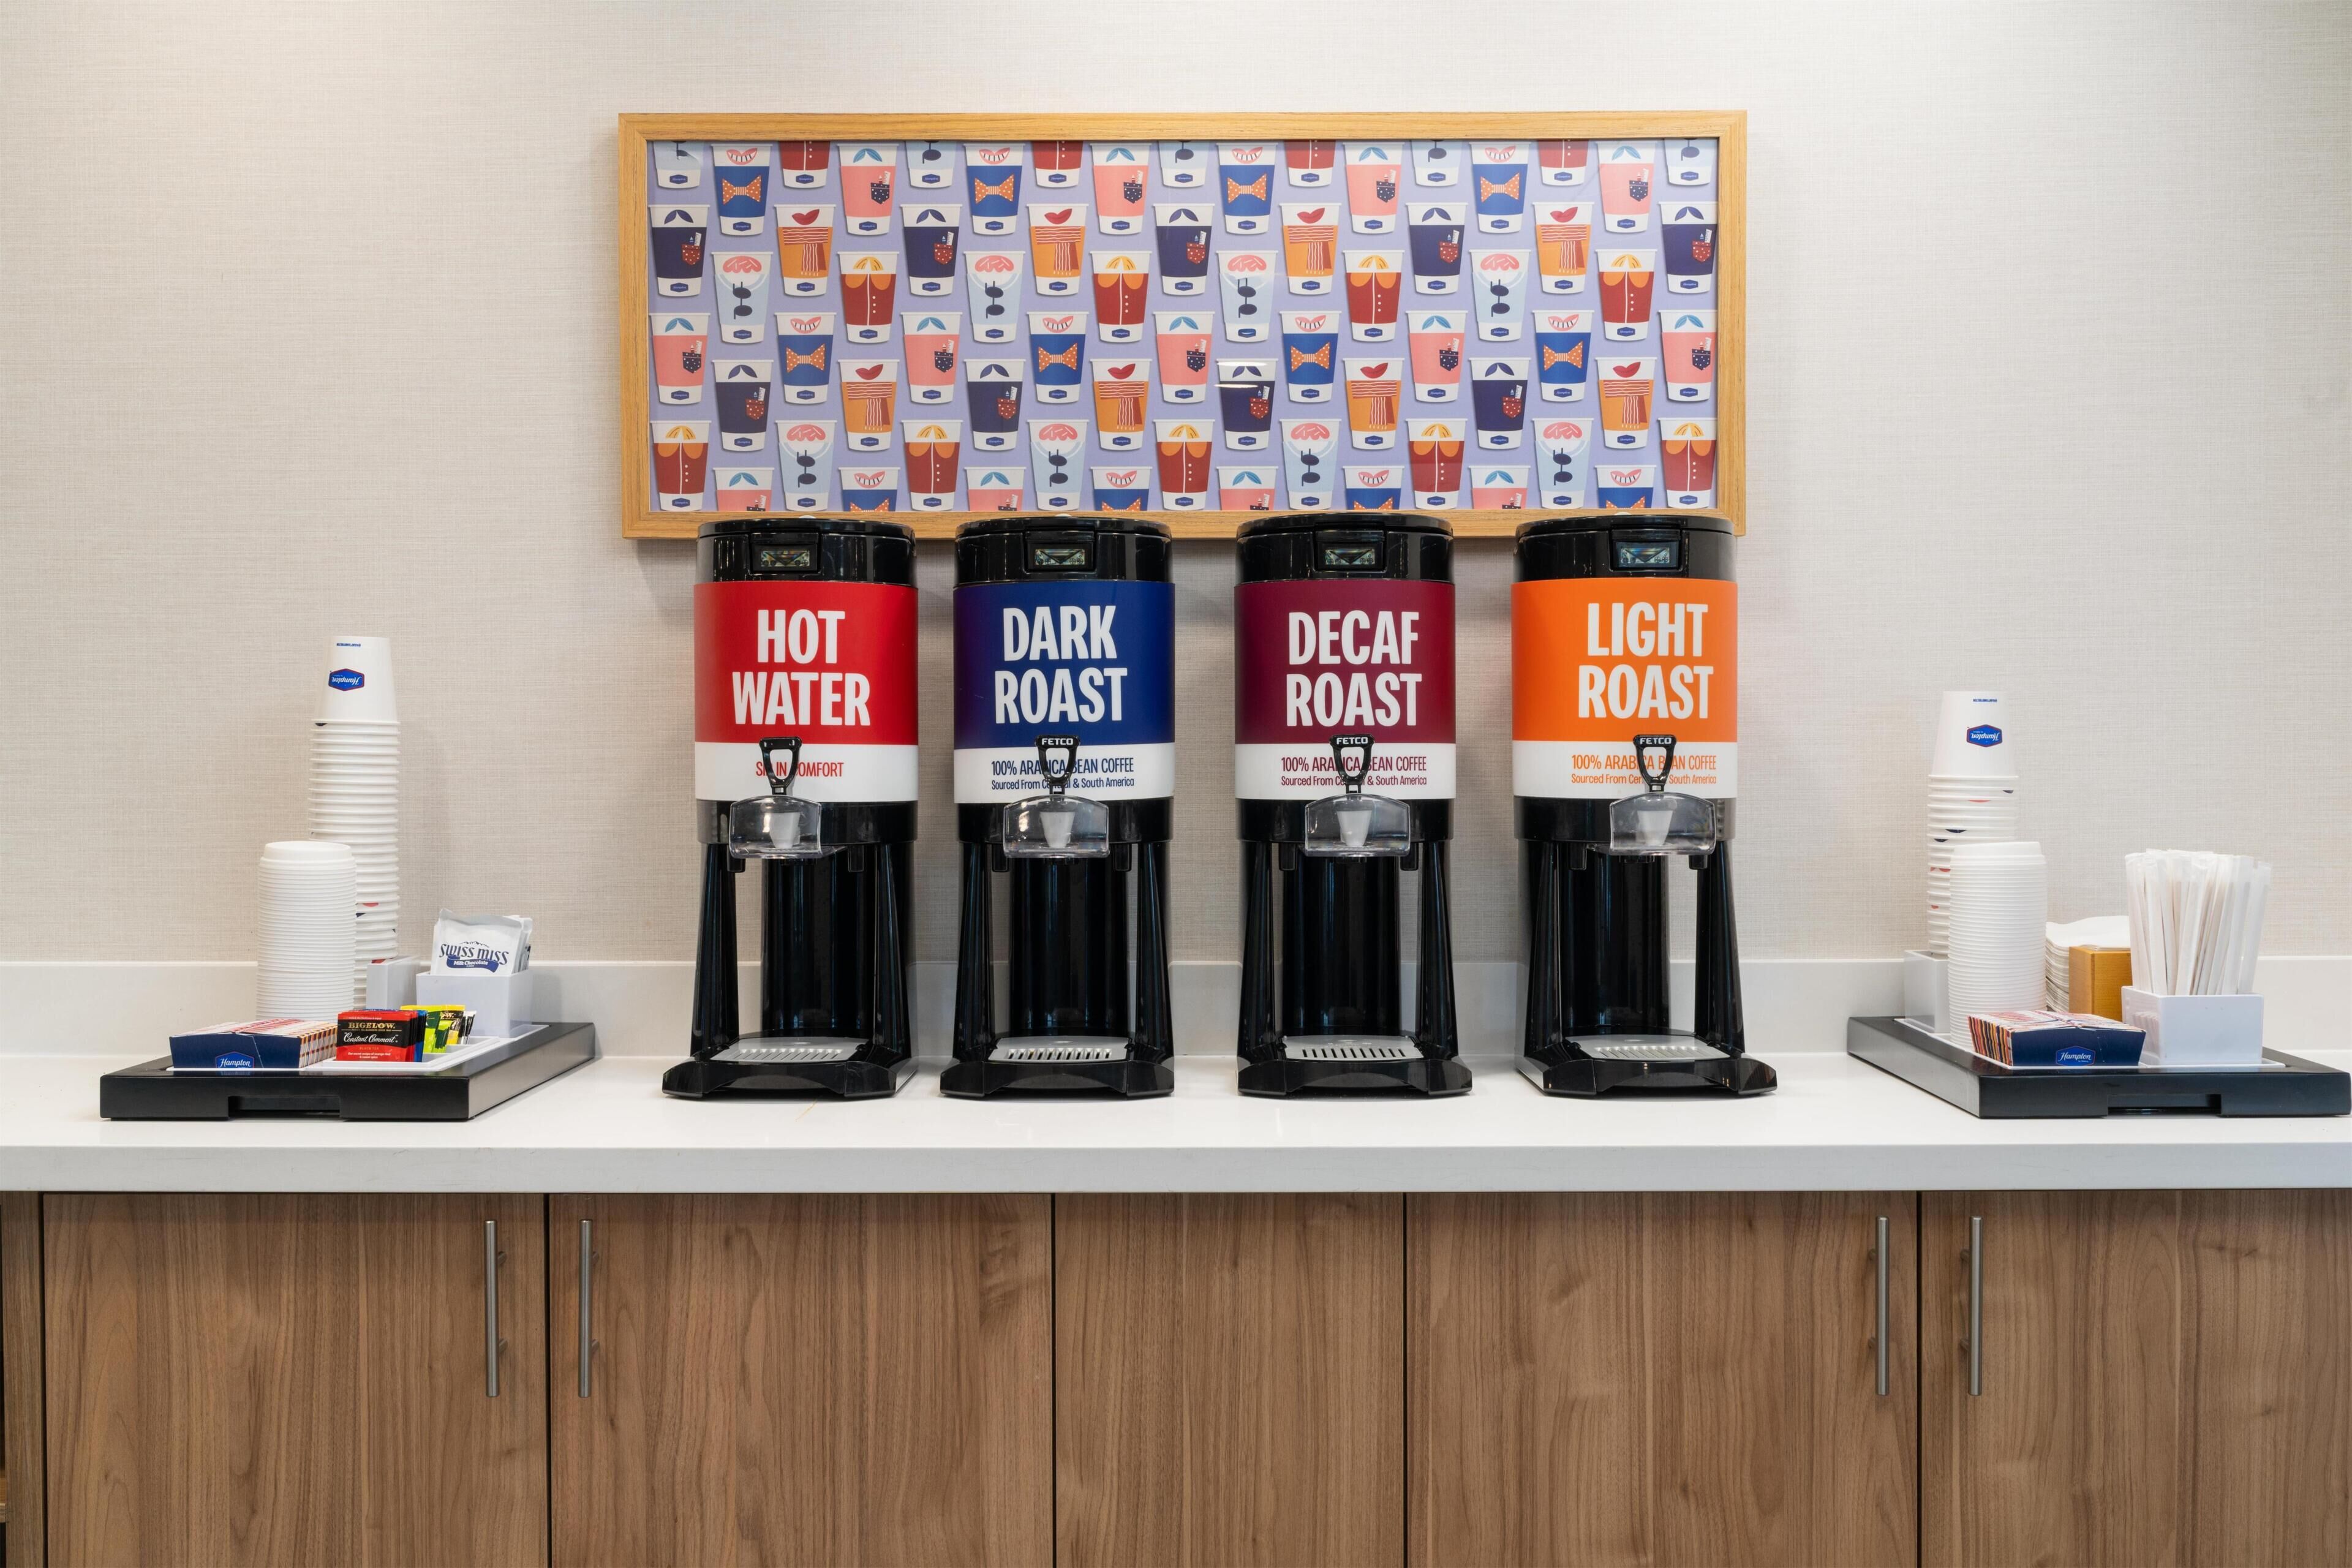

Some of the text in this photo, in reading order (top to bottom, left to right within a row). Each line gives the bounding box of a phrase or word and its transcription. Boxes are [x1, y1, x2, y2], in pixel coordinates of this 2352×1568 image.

[758, 609, 845, 664] HOT
[1004, 605, 1117, 662] DARK
[1289, 609, 1419, 665] DECAF
[1588, 602, 1708, 657] LIGHT
[331, 676, 361, 685] Hampton
[733, 672, 870, 726] WATER
[995, 667, 1128, 724] ROAST
[1286, 672, 1422, 727] ROAST
[1578, 665, 1713, 719] ROAST
[1970, 733, 2000, 741] Hampton
[756, 761, 844, 777] SI IN OMFORT
[991, 760, 1017, 775] 100%
[1019, 759, 1066, 775] ARAICA
[1101, 757, 1134, 773] COFFEE
[1281, 757, 1309, 772] 100%
[1311, 756, 1360, 772] ARAICA
[1396, 756, 1427, 771] COFFEE
[1572, 755, 1602, 770] 100%
[1658, 755, 1686, 770] BAN
[1689, 755, 1717, 770] COFFEE
[992, 776, 1134, 790] Sourced From Ceal & South America
[1281, 775, 1311, 786] Sourced
[1313, 776, 1333, 786] From
[1367, 775, 1374, 785] &
[1376, 775, 1398, 786] South
[1400, 775, 1427, 785] America
[1571, 774, 1604, 784] Sourced
[1605, 774, 1627, 784] From
[1669, 774, 1691, 785] South
[1692, 774, 1716, 784] America
[439, 943, 475, 958] SWISS
[217, 1058, 252, 1068] Hampton
[2057, 1052, 2092, 1062] Hampton
